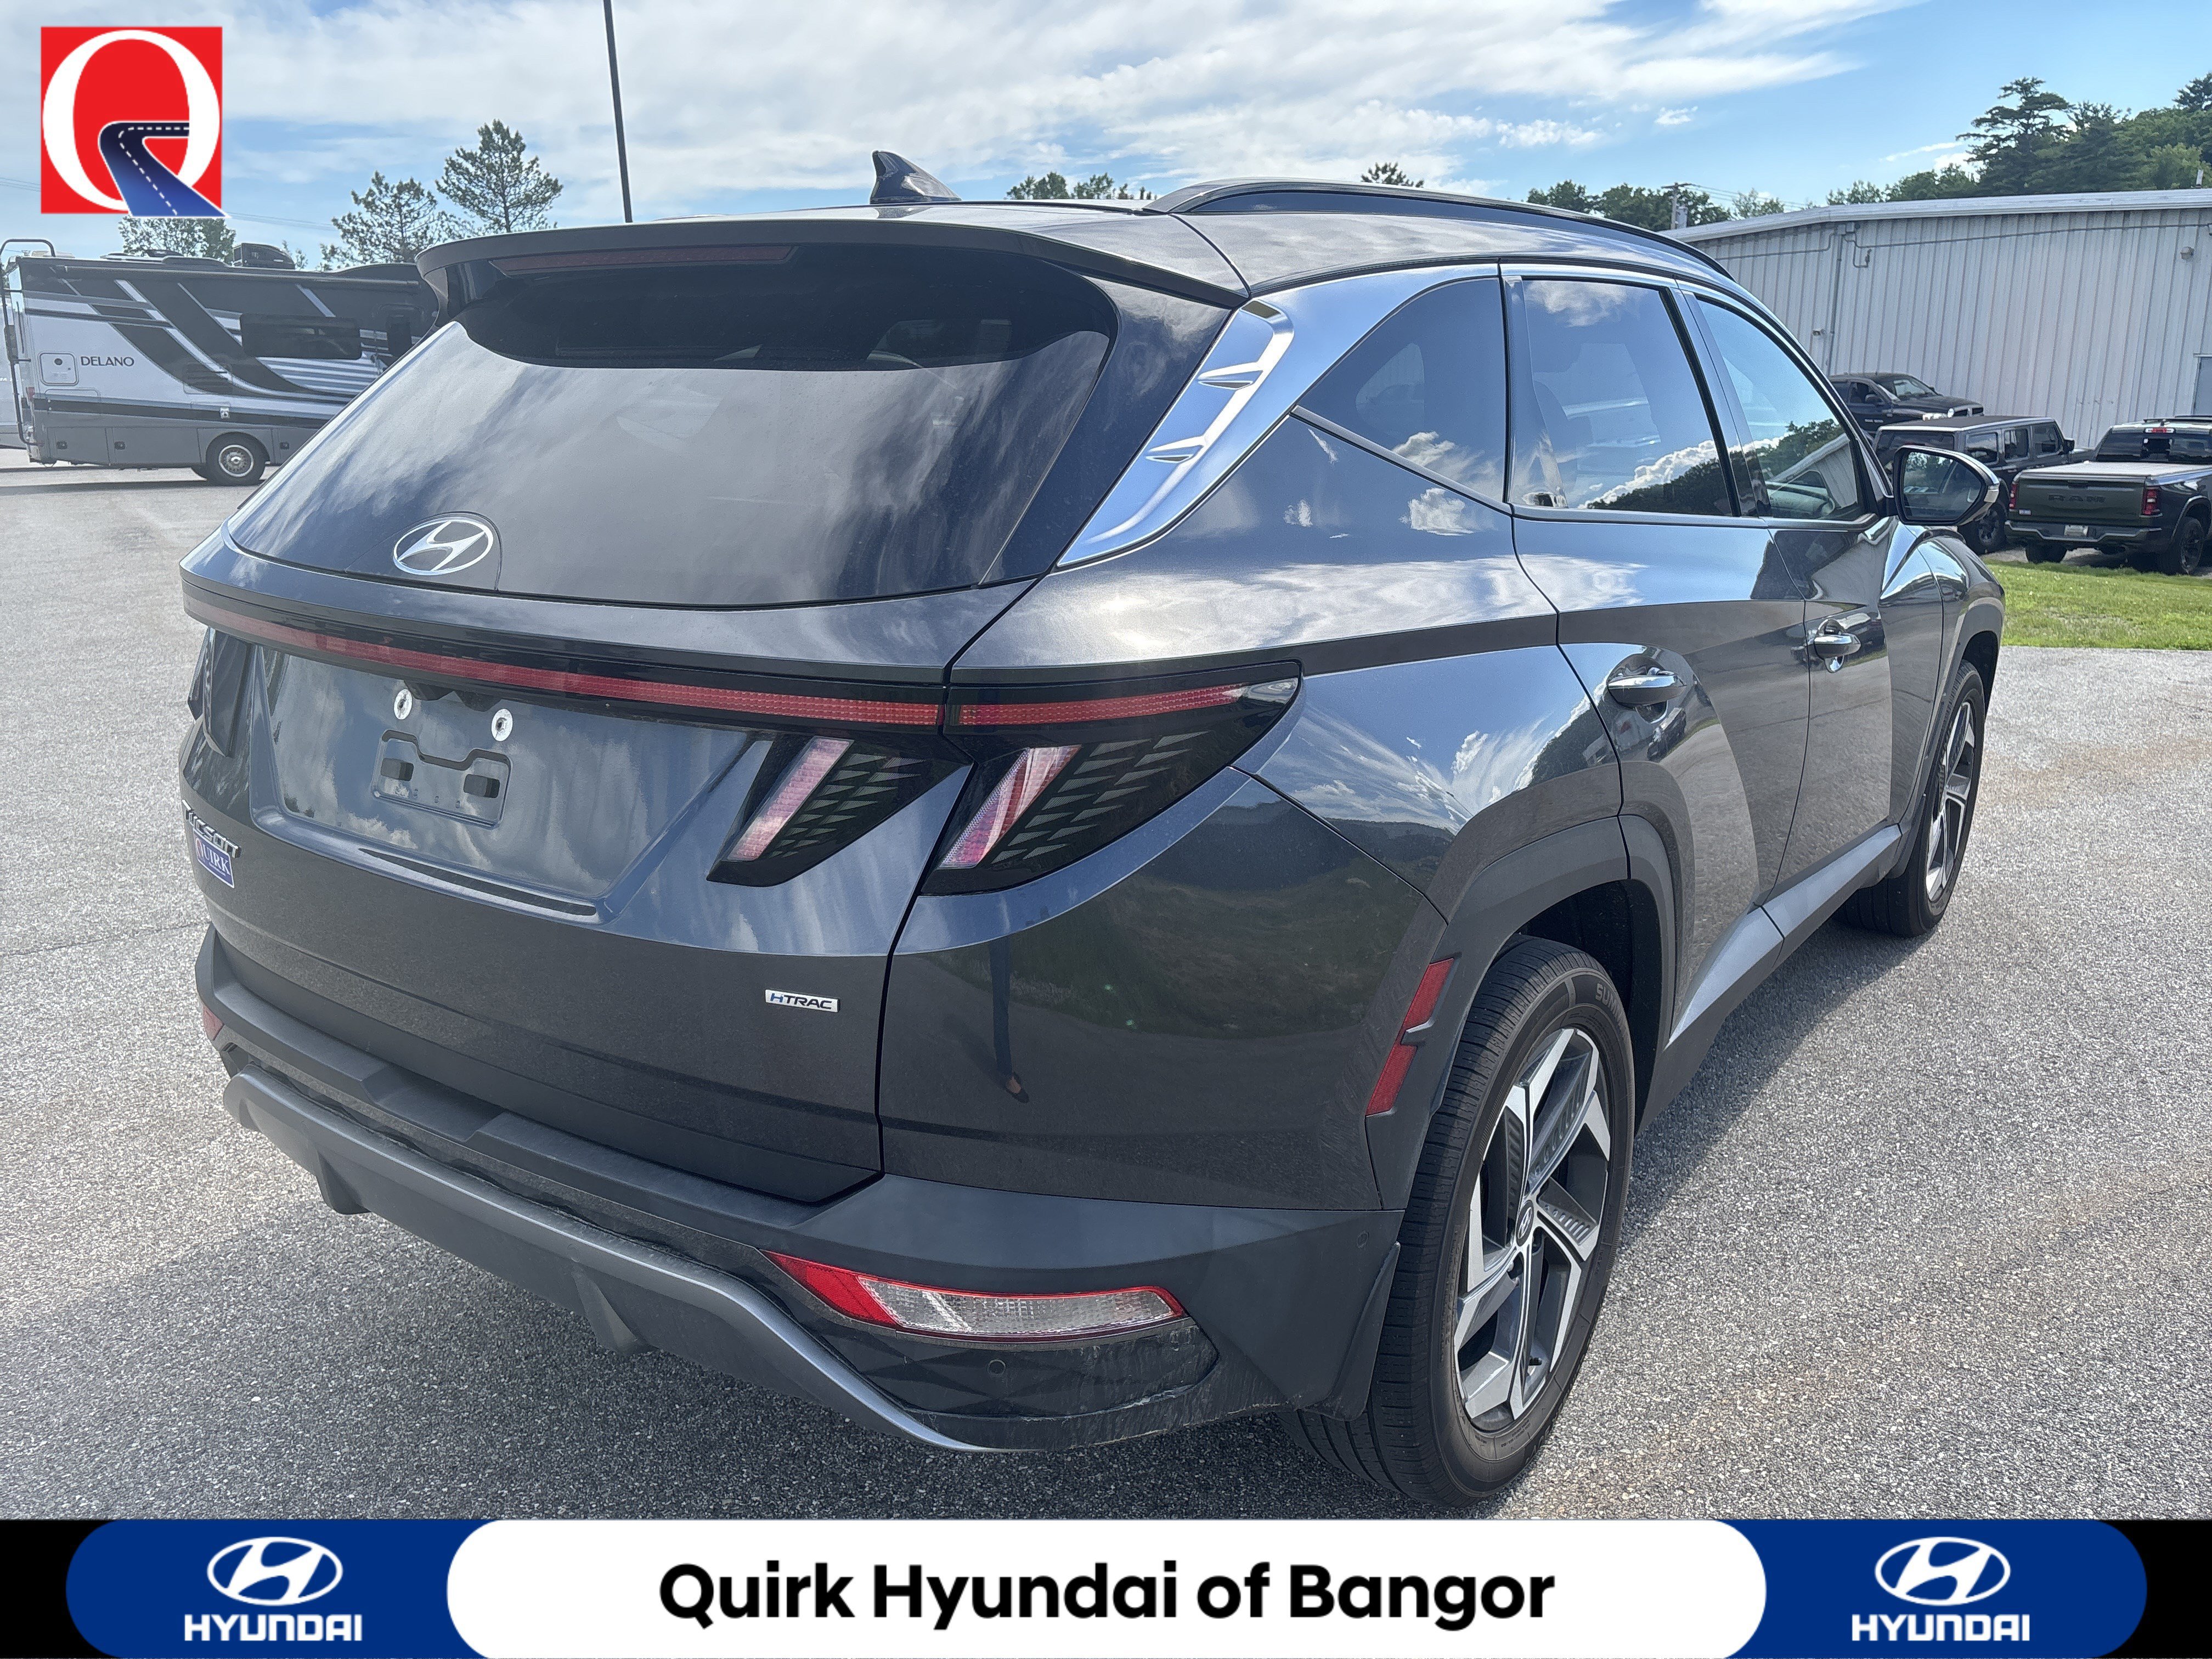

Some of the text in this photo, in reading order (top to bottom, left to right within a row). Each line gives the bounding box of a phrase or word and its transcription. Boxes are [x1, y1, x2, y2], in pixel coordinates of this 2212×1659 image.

[80, 356, 135, 367] DELANO
[195, 837, 231, 876] QUIRK
[770, 992, 833, 1010] HTRAC
